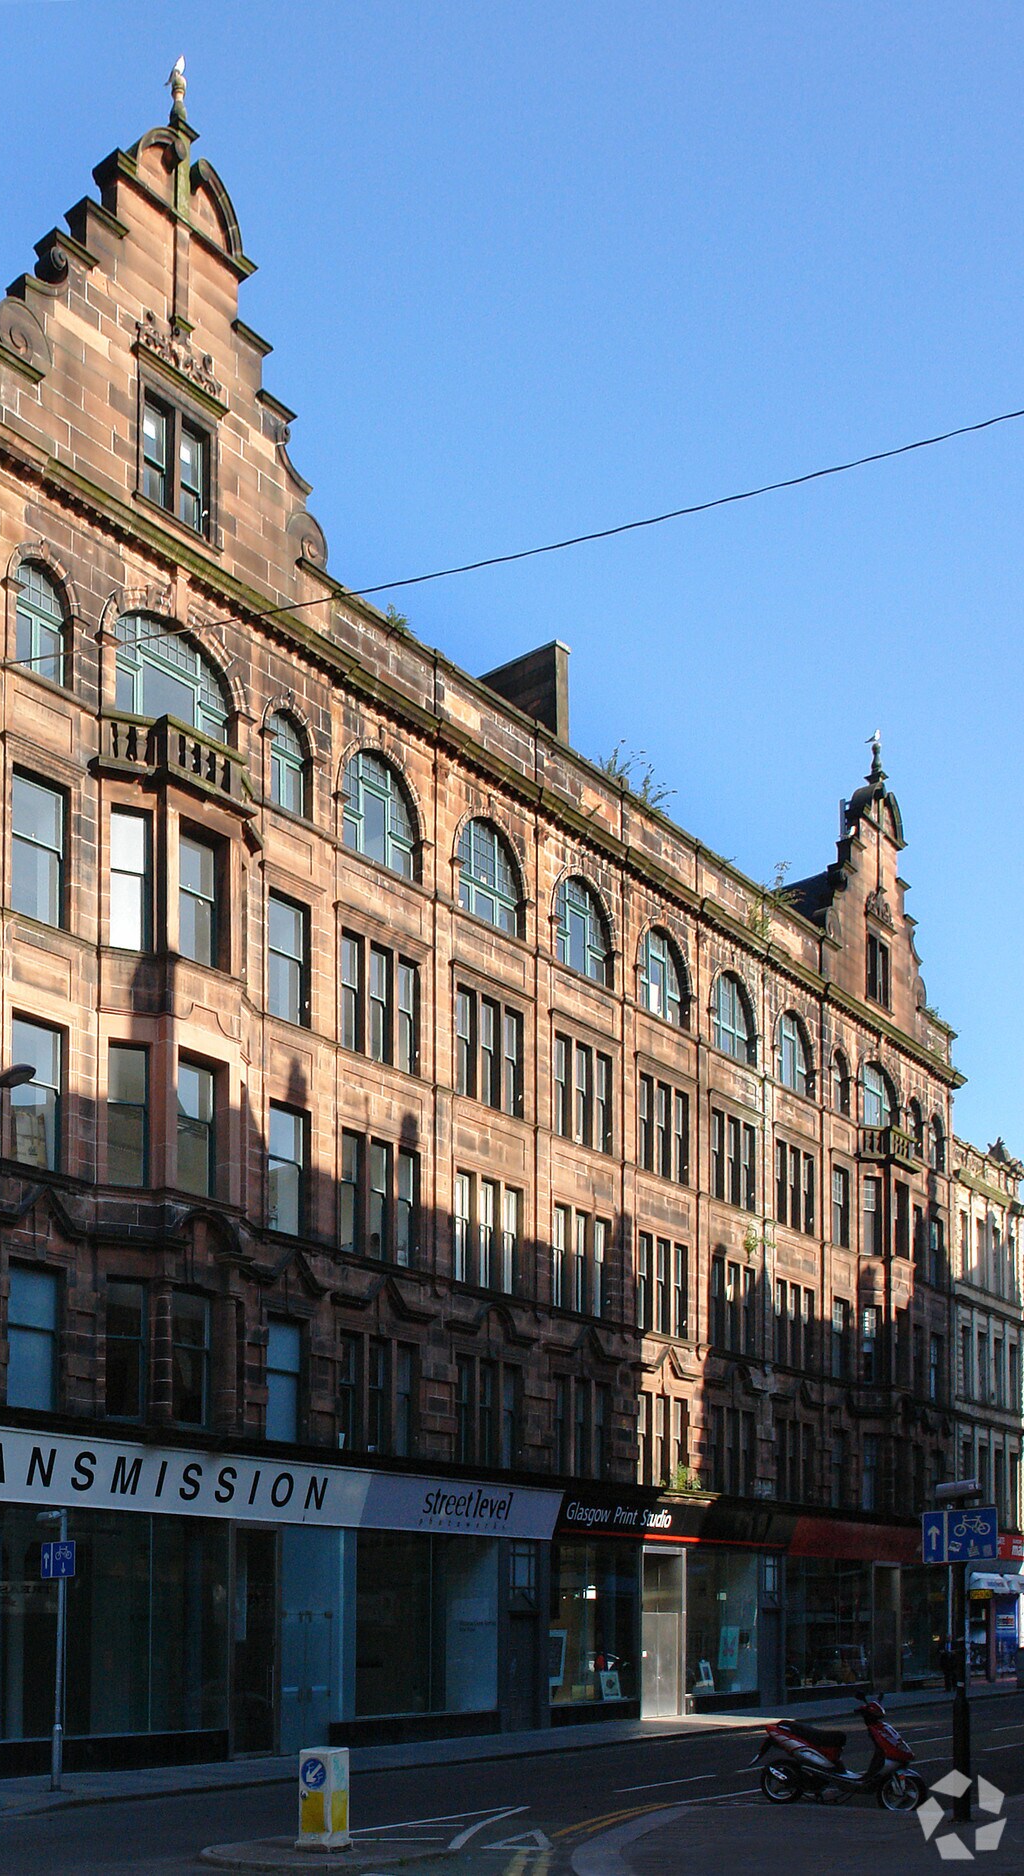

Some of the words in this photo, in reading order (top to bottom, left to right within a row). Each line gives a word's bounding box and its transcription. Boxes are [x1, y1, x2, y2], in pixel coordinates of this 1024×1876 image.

[566, 1502, 611, 1526] Glasgow
[613, 1506, 638, 1525] Print
[639, 1509, 672, 1529] Studio
